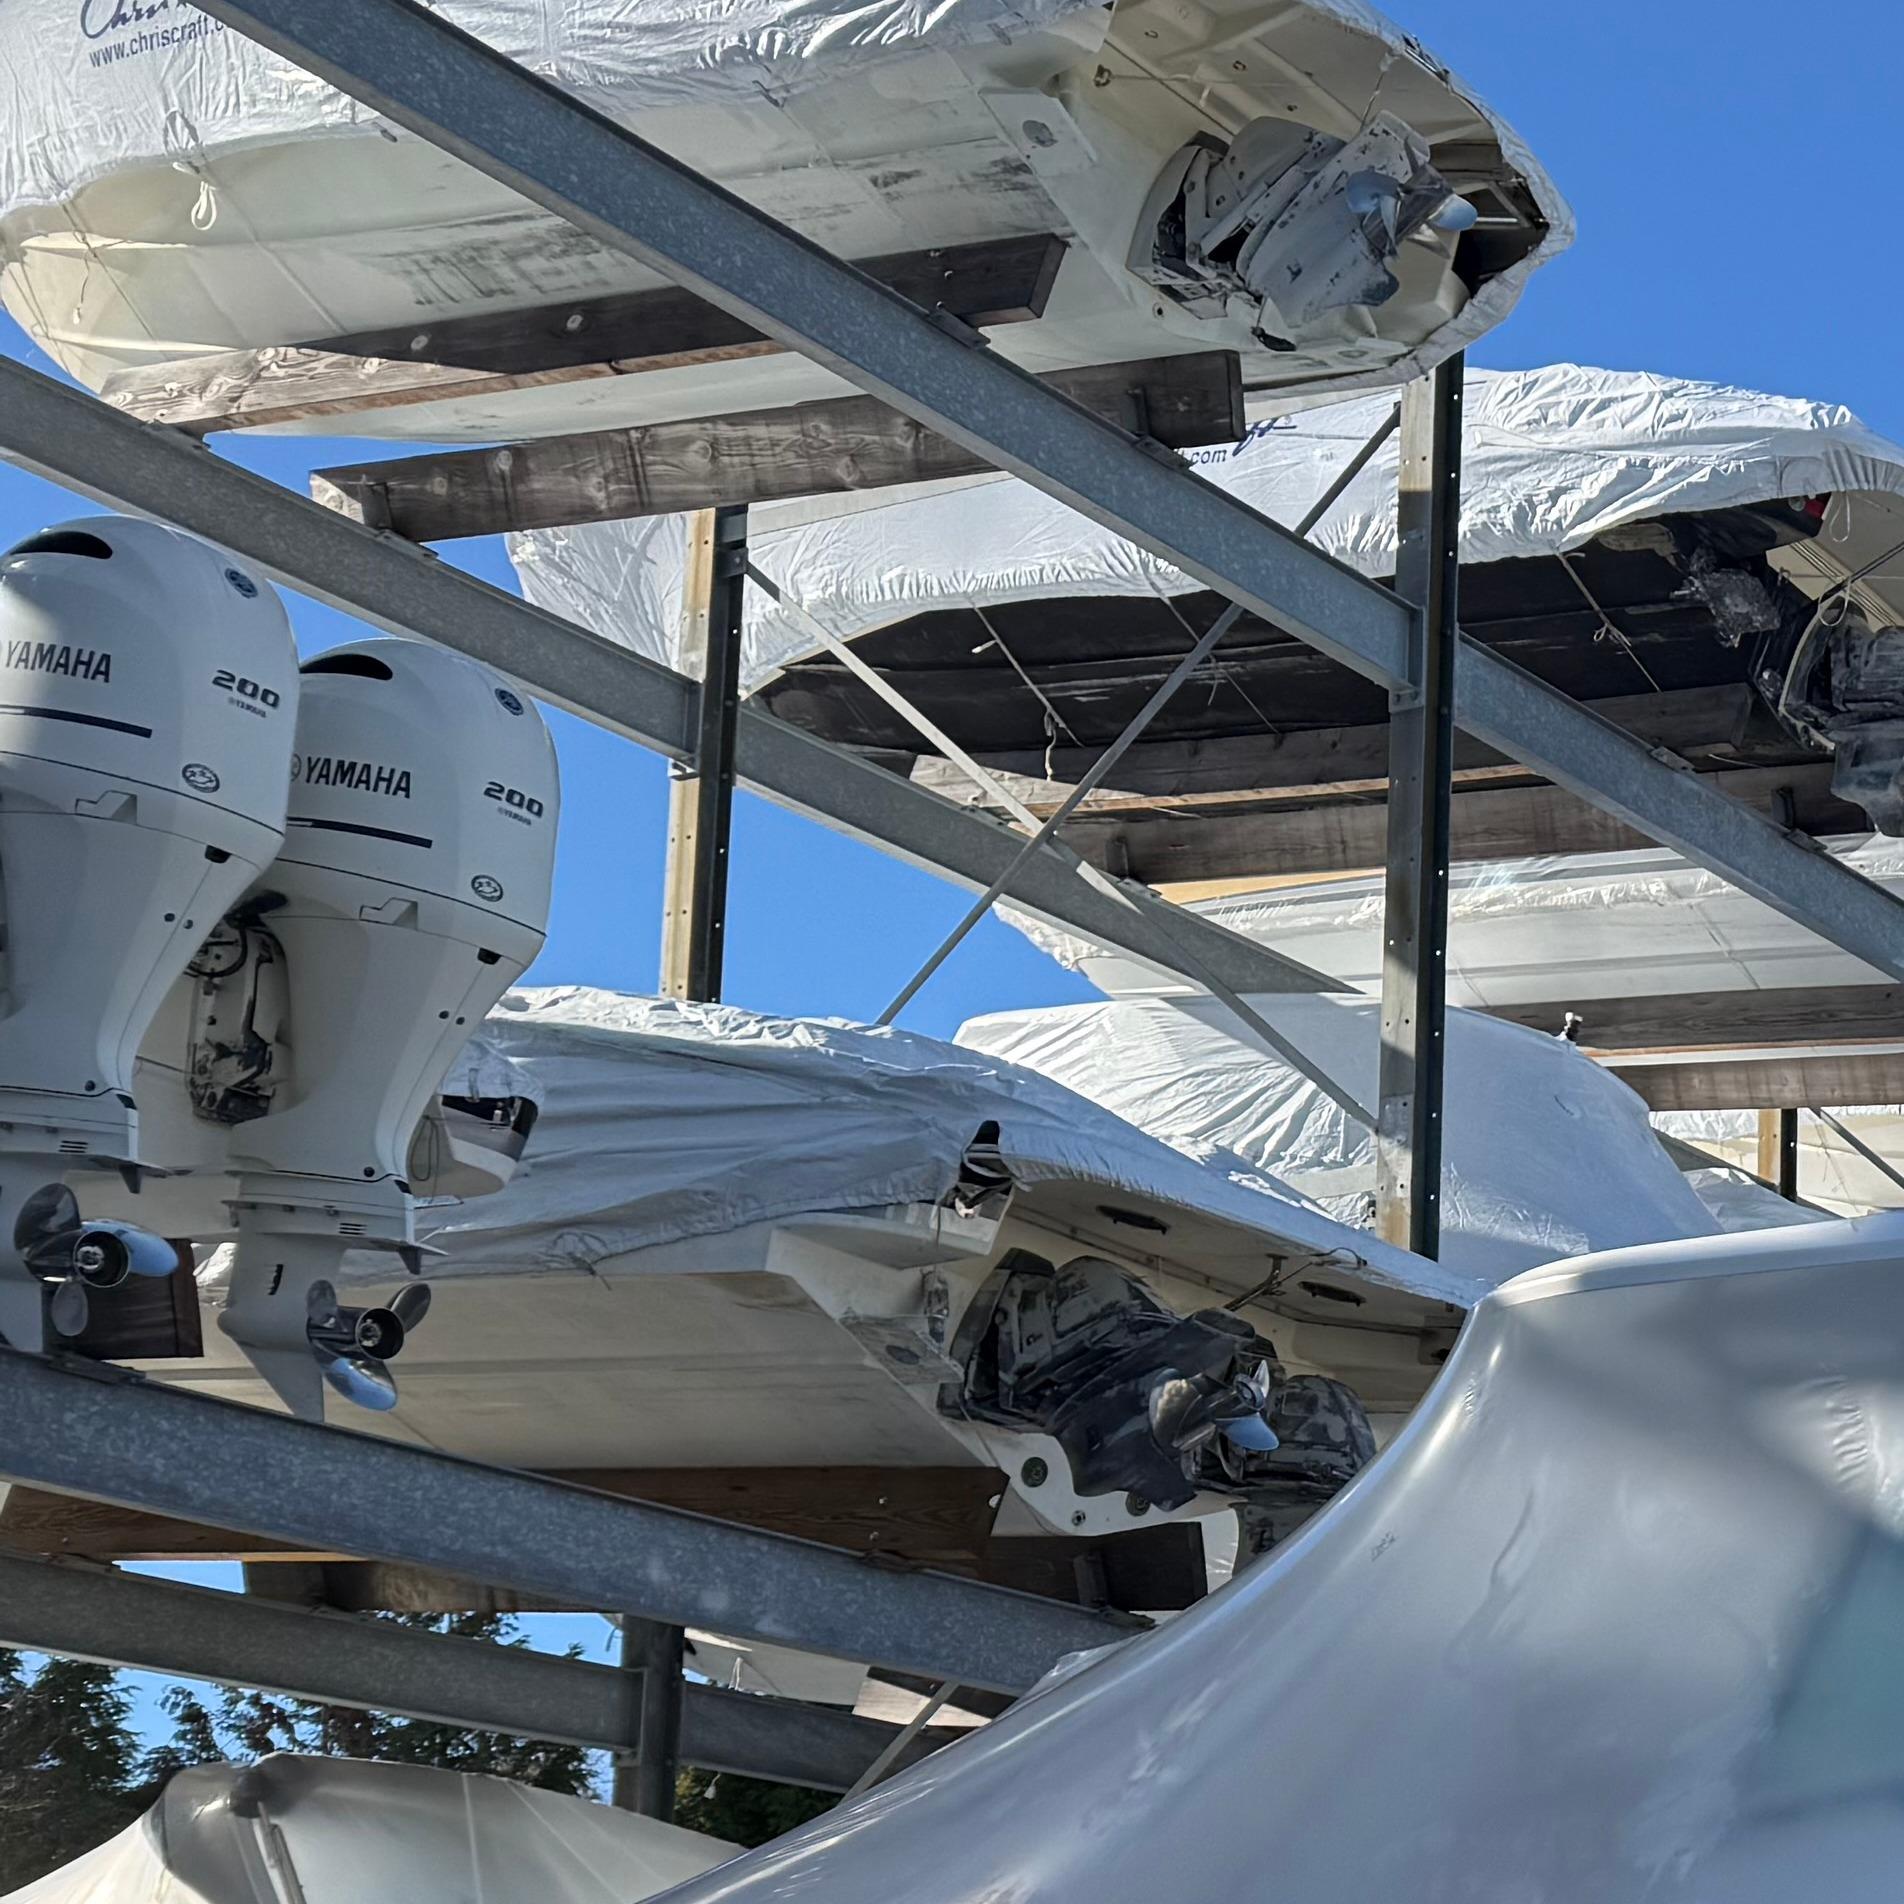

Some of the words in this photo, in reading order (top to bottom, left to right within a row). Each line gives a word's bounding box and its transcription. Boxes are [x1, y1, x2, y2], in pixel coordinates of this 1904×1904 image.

[6, 640, 111, 683] YAMAHA
[211, 669, 280, 708] 200
[305, 756, 411, 799] YAMAHA
[483, 781, 544, 818] 200
